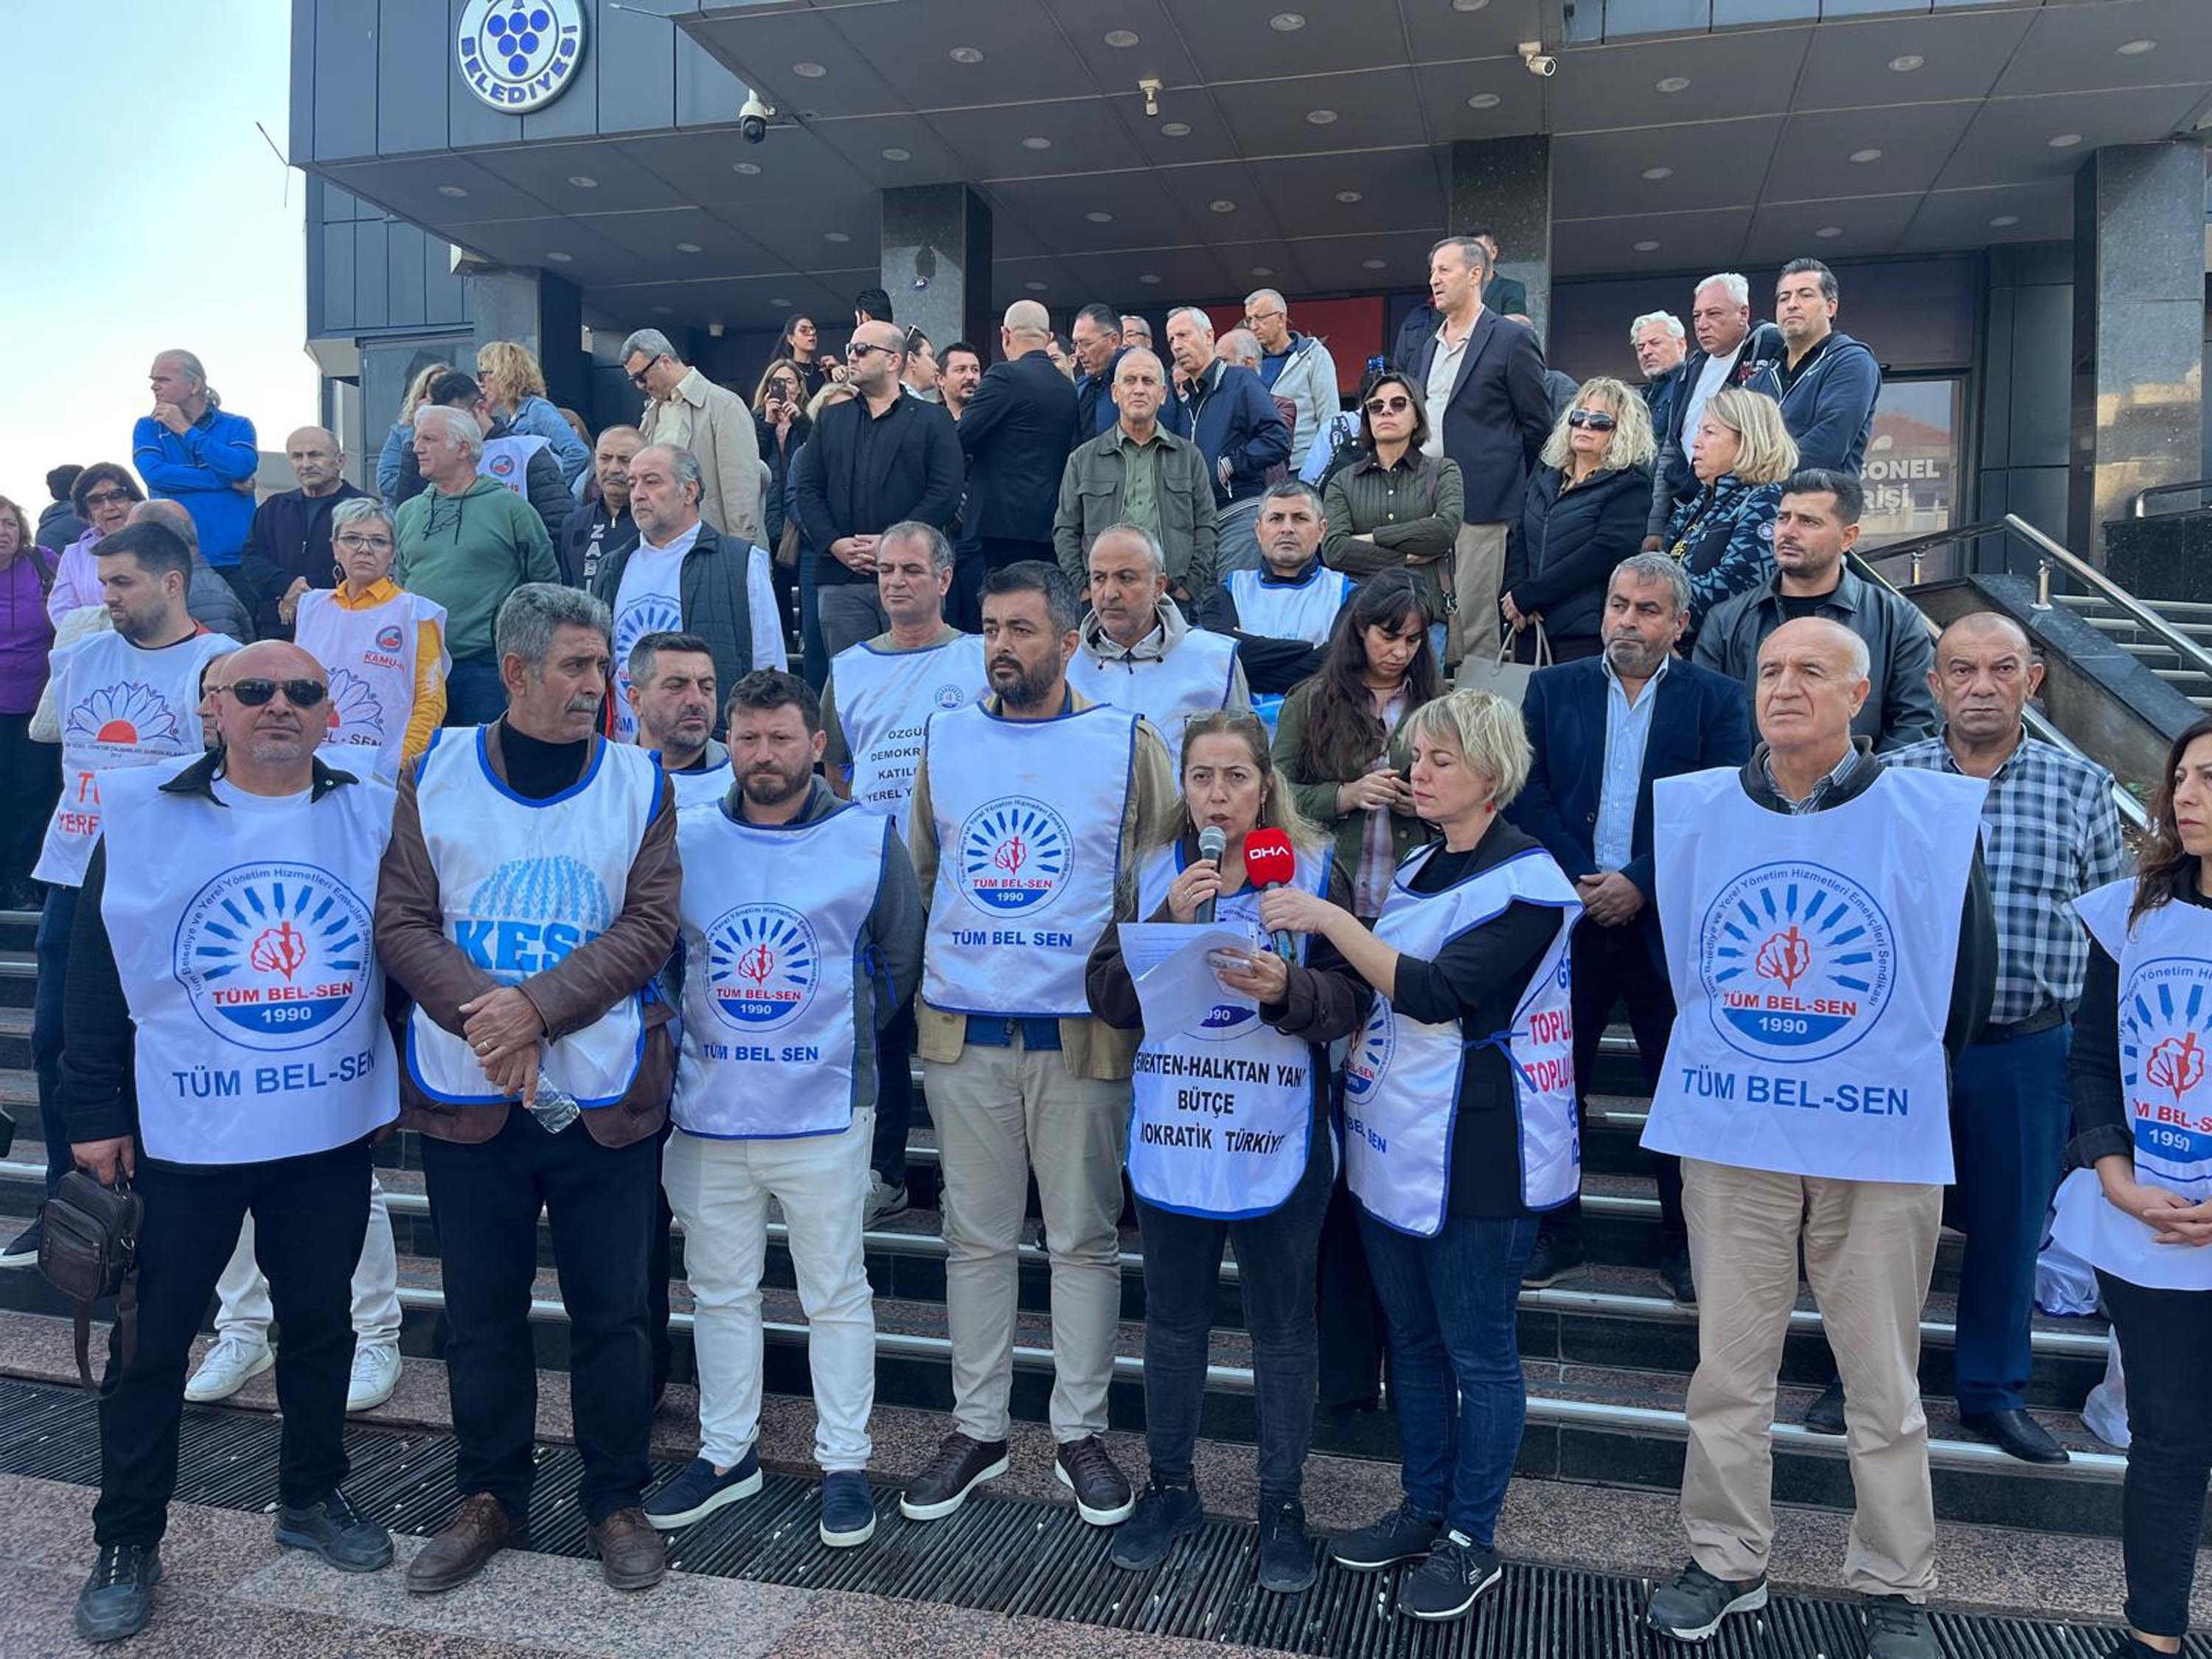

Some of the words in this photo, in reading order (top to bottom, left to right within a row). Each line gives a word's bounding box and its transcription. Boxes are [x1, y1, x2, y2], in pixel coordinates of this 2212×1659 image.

[871, 748, 920, 762] DEMOKR
[866, 787, 902, 803] YEREL
[1249, 846, 1290, 860] DHA
[223, 869, 271, 888] Yönetim
[1001, 879, 1052, 888] BEL-SEN
[997, 892, 1023, 902] 1990
[952, 929, 987, 945] TÜM
[992, 931, 1026, 945] BEL
[1034, 932, 1073, 947] SEN
[1719, 886, 1741, 909] Yerel
[1741, 868, 1787, 889] Yönetim
[1792, 869, 1851, 895] Hizmetleri
[1848, 891, 1885, 947] Emekçileri
[1869, 950, 1889, 1006] Sendikası
[455, 920, 599, 972] KES
[212, 987, 260, 1005] TÜM
[268, 981, 354, 1001] BEL-SEN
[746, 989, 801, 1000] BEL-SEN
[740, 1004, 771, 1014] 1990
[1723, 990, 1759, 1008] TÜM
[1766, 995, 1857, 1016] BEL-SEN
[261, 1006, 312, 1023] 1990
[1758, 1017, 1806, 1034] 1990
[735, 1046, 775, 1062] BEL
[782, 1046, 818, 1062] SEN
[172, 1065, 241, 1097] TÜM
[256, 1048, 377, 1094] BEL-SEN
[1682, 1065, 1735, 1100] TÜM
[1747, 1075, 1908, 1116] BEL-SEN
[1178, 1086, 1234, 1119] BÜTÇE
